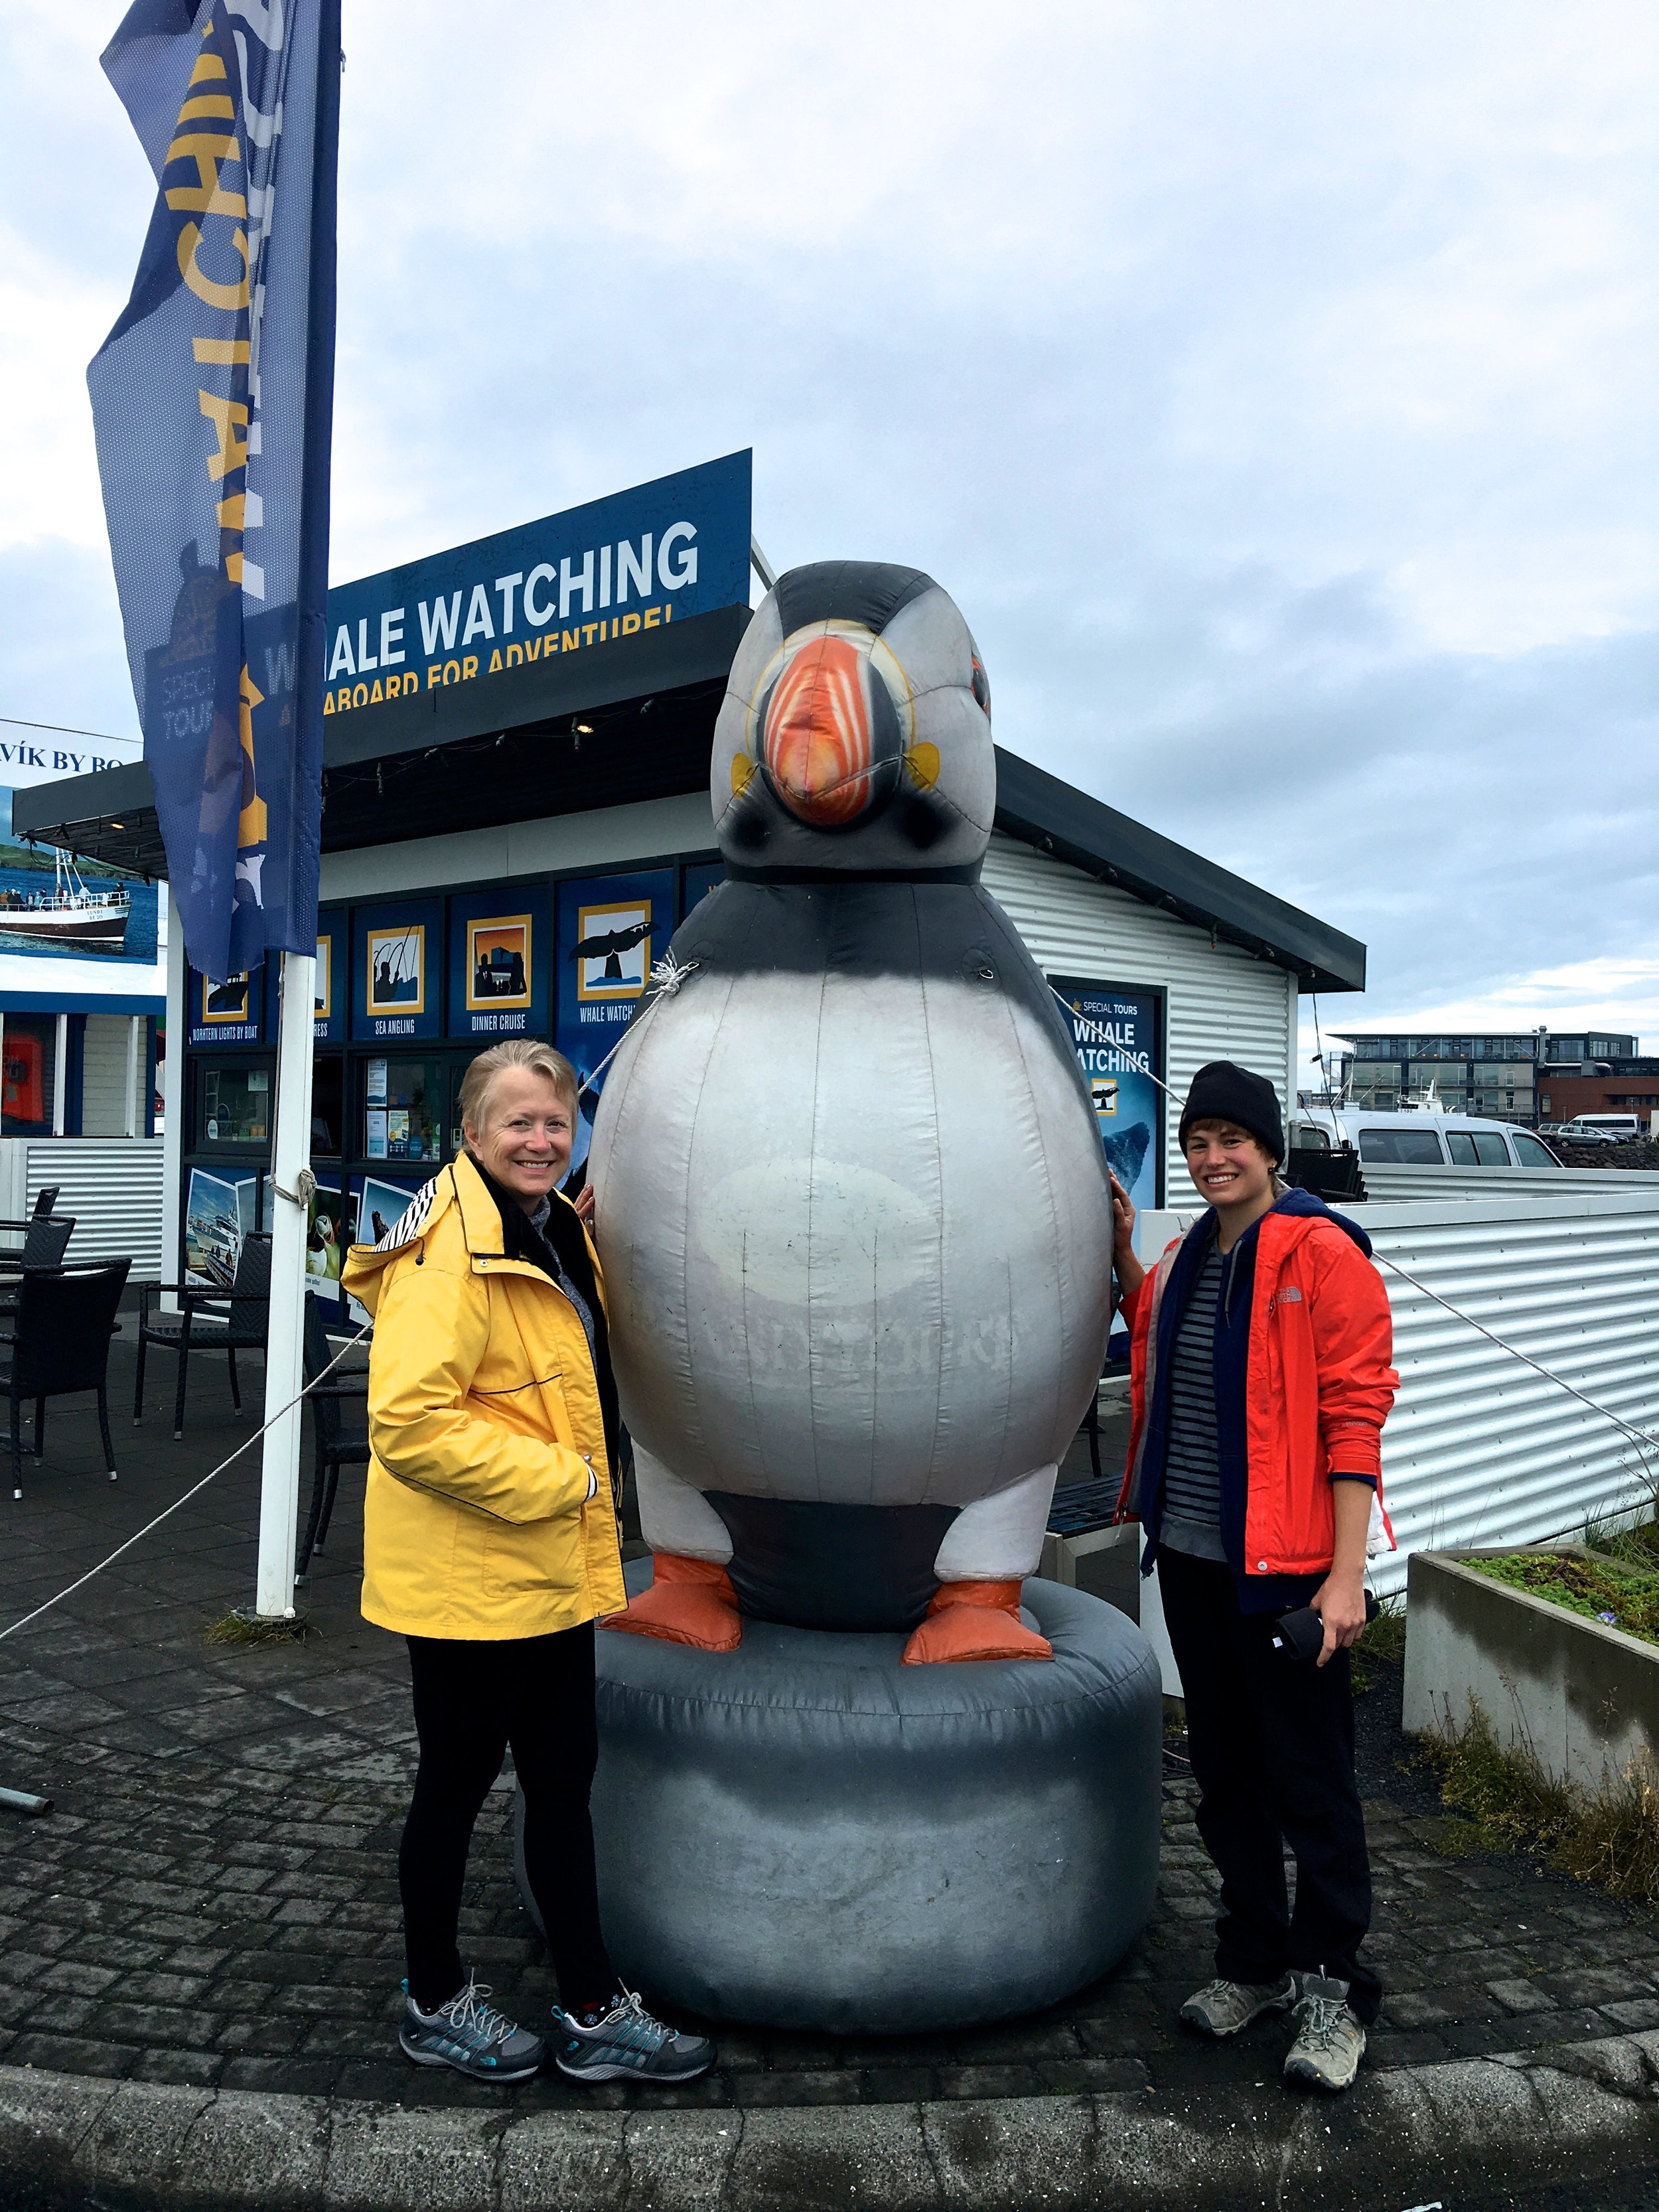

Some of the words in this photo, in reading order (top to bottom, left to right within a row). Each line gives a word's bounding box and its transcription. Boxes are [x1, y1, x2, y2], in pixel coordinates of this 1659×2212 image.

[417, 521, 697, 656] WATCHING
[323, 672, 419, 715] ABOARD
[427, 655, 478, 689] FOR
[0, 741, 46, 768] VÍK
[52, 750, 86, 773] BY
[580, 1007, 605, 1023] WHALE
[607, 1005, 636, 1021] WATCH
[1083, 1001, 1112, 1013] SPECIAL
[1114, 1004, 1137, 1015] TOURS
[376, 1021, 386, 1035] SEA
[388, 1019, 415, 1034] ANGLING
[472, 1015, 498, 1031] DINNER
[500, 1014, 526, 1029] CRUISE
[1073, 1019, 1134, 1044] WHALE
[219, 1027, 236, 1040] LIGHTS
[237, 1026, 244, 1039] BY
[245, 1025, 257, 1039] BOAT
